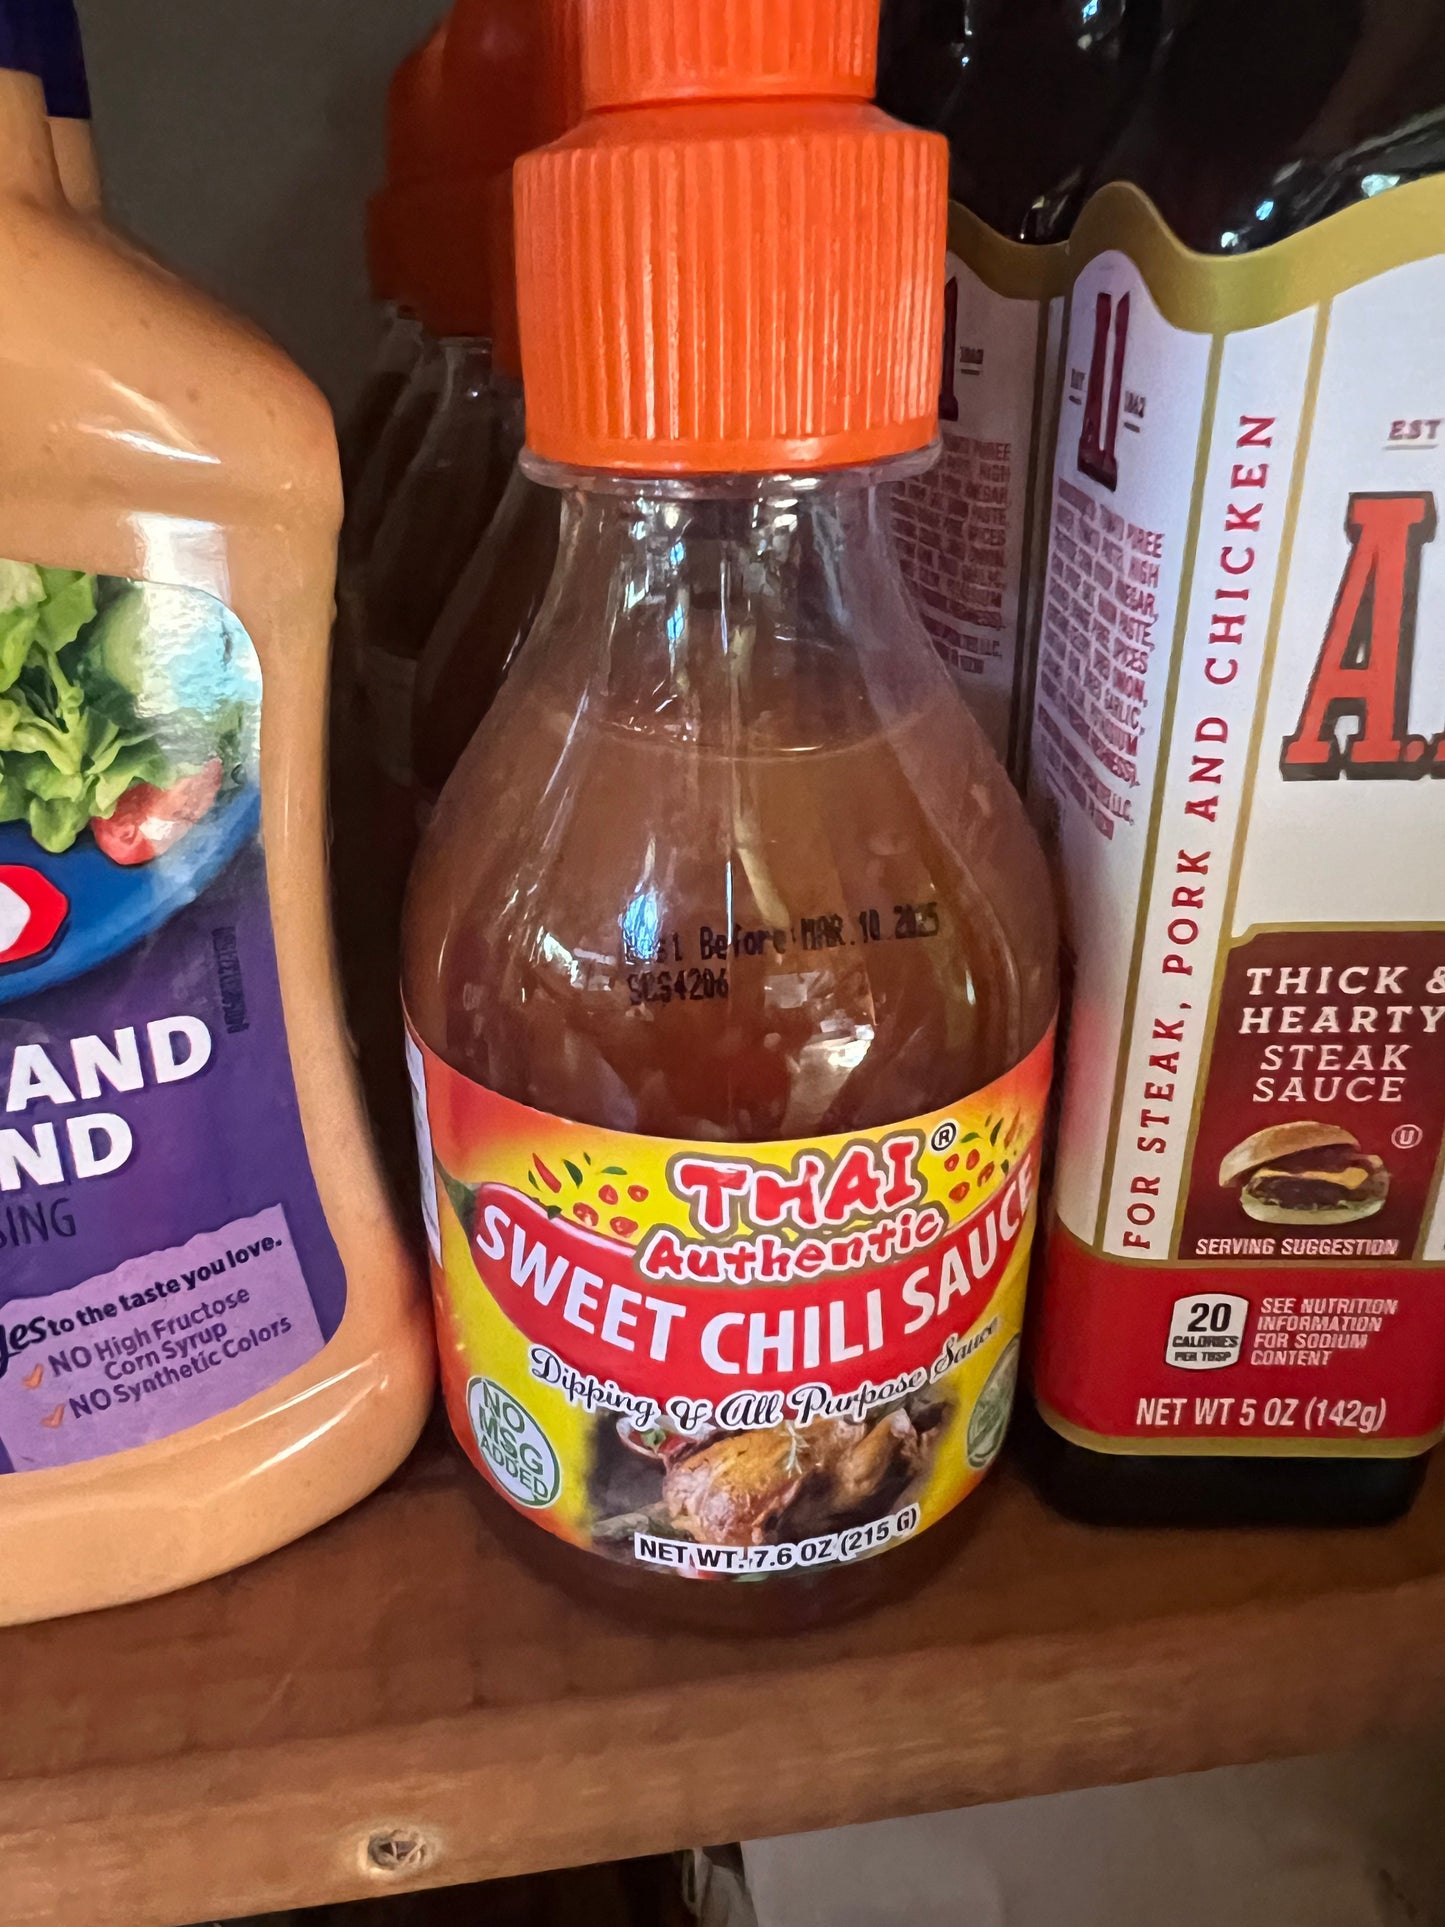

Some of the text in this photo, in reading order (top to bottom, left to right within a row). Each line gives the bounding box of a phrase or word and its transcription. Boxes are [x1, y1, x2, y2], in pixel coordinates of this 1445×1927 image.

[1122, 414, 1276, 1250] FOR STEAK, PORK AND CHICKEN
[1246, 966, 1409, 996] THICK
[1238, 1005, 1445, 1034] HEARTY
[1260, 1044, 1413, 1071] STEAK
[1252, 1076, 1407, 1103] SAUCE
[676, 1136, 921, 1233] THAI
[0, 1197, 76, 1247] ING
[642, 1210, 943, 1283] Authentic
[1196, 1238, 1400, 1255] SERVING SUGGESTION
[48, 1317, 75, 1337] to
[76, 1305, 118, 1327] the
[118, 1276, 181, 1312] taste
[180, 1258, 227, 1291] you
[226, 1236, 283, 1269] love.
[476, 1153, 1034, 1375] SWEET CHILI SAUCE
[1187, 1302, 1232, 1332] 20
[1257, 1316, 1383, 1332] INFORMATION
[1260, 1298, 1399, 1315] SEE NUTRITION
[48, 1288, 251, 1377] NO High Fructose
[104, 1321, 228, 1381] Corn Syrup
[1172, 1335, 1239, 1348] CALORIES
[1174, 1351, 1198, 1362] PER
[1253, 1333, 1369, 1349] FOR SODIUM
[68, 1316, 292, 1419] NO Synthetic Colors
[1250, 1350, 1332, 1366] CONTENT
[482, 1380, 525, 1434] NO
[531, 1347, 655, 1427] Dipping
[719, 1393, 783, 1425] All
[792, 1369, 923, 1424] Purpose
[479, 1402, 544, 1476] MSG
[1136, 1396, 1387, 1433] NET WT 5 OZ (142g)
[480, 1434, 549, 1499] ADDED
[639, 1537, 688, 1564] NET
[755, 1546, 793, 1568] 7.6
[800, 1540, 833, 1562] OZ
[840, 1521, 890, 1557] (215
[896, 1508, 918, 1533] G)
